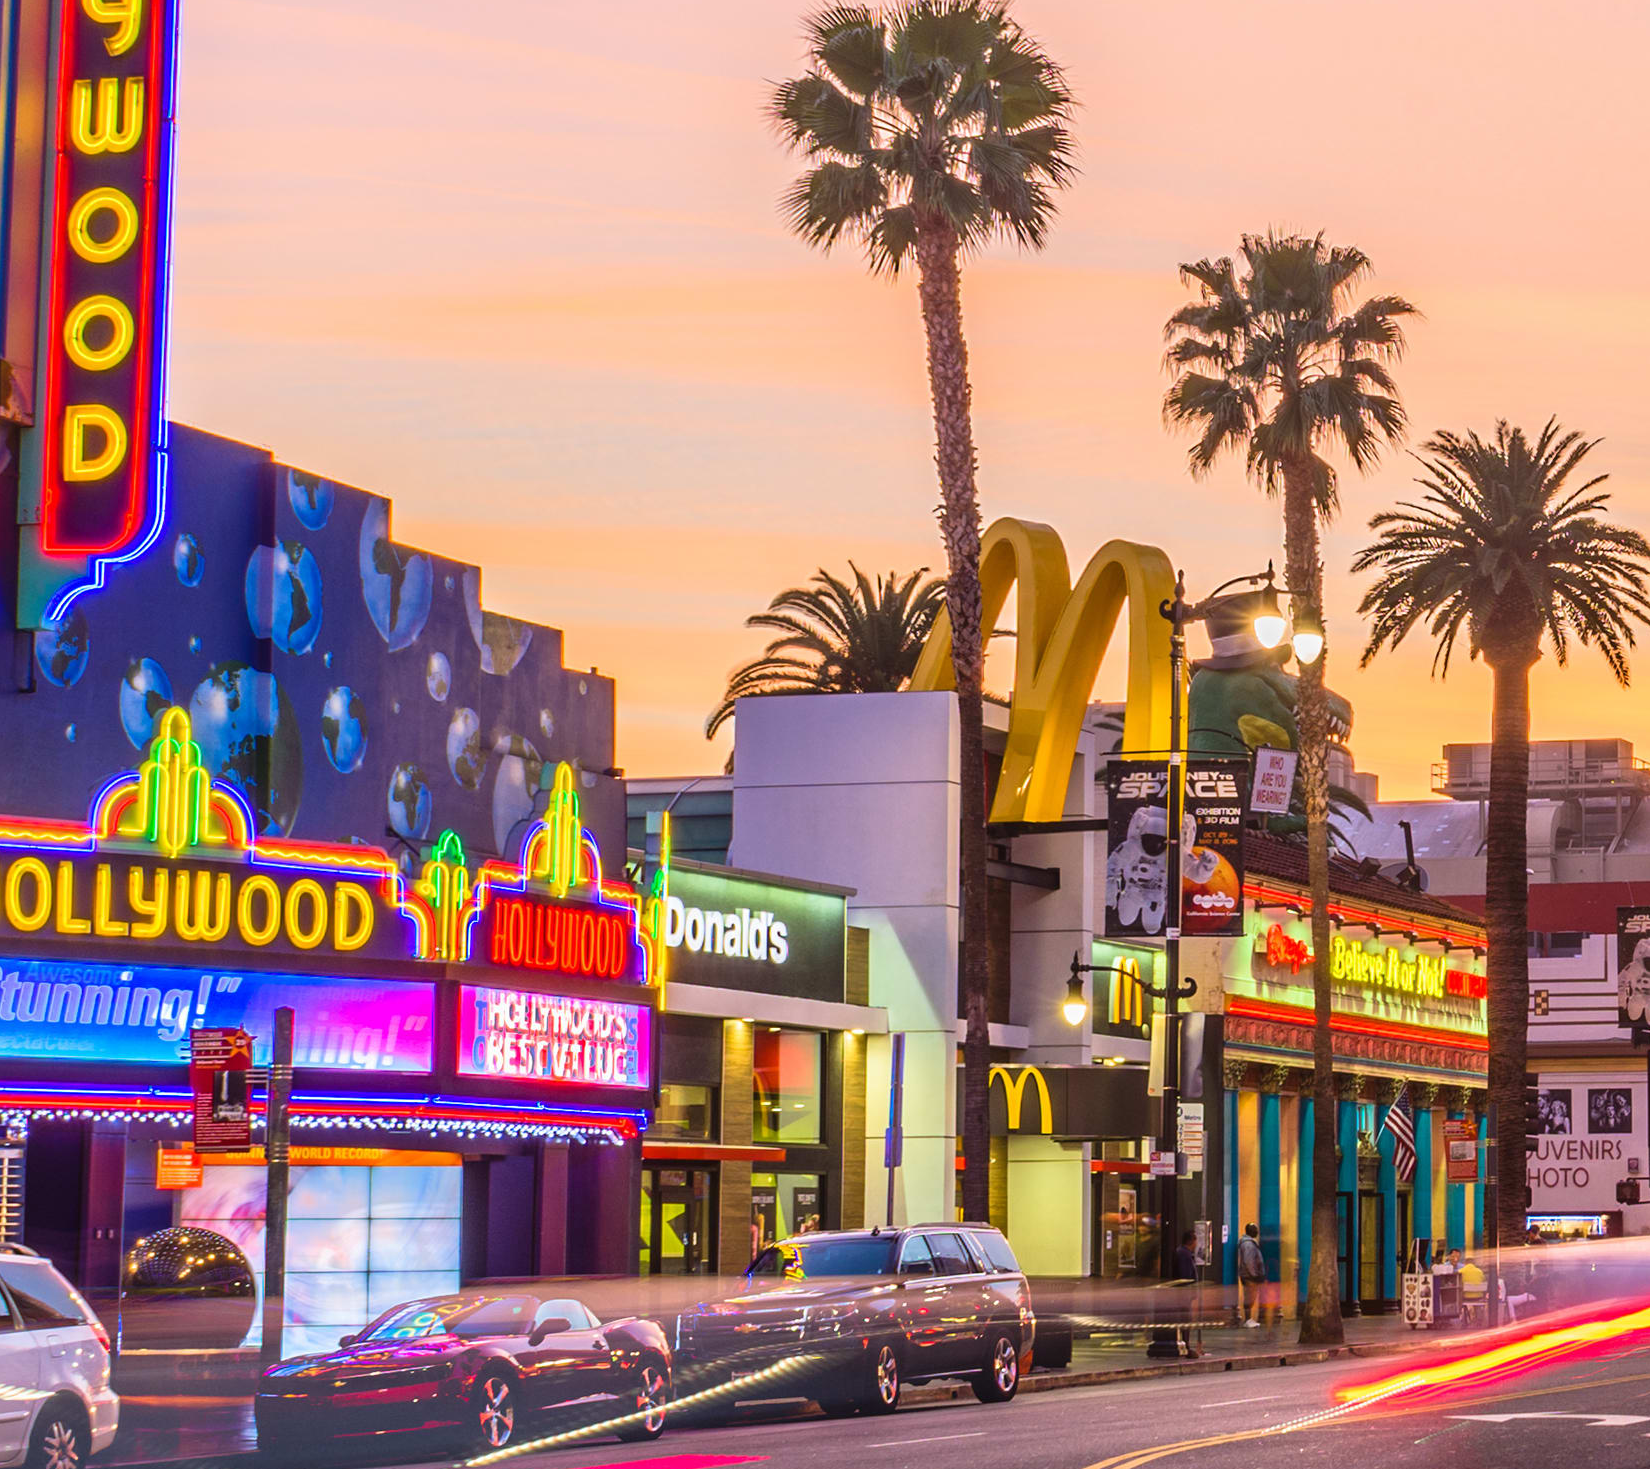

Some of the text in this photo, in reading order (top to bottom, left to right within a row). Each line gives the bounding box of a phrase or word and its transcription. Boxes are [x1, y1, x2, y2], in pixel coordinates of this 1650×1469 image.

[1269, 756, 1284, 772] WHO
[1260, 773, 1288, 788] ARE YOU
[1116, 781, 1239, 799] SPACE
[1255, 789, 1288, 806] WEARING?
[1195, 807, 1241, 817] EXHIBITION
[1204, 816, 1240, 826] 3D FILM
[491, 896, 627, 979] HOLLYWOOD
[666, 896, 789, 964] Donald's
[1332, 935, 1384, 985] Believe
[1384, 946, 1401, 989] It
[1400, 961, 1416, 992] or
[1415, 954, 1447, 999] Not!
[291, 1148, 384, 1160] WORLD RECORD!
[1526, 1139, 1623, 1161] UVENIRS
[1527, 1167, 1590, 1188] HOTO
